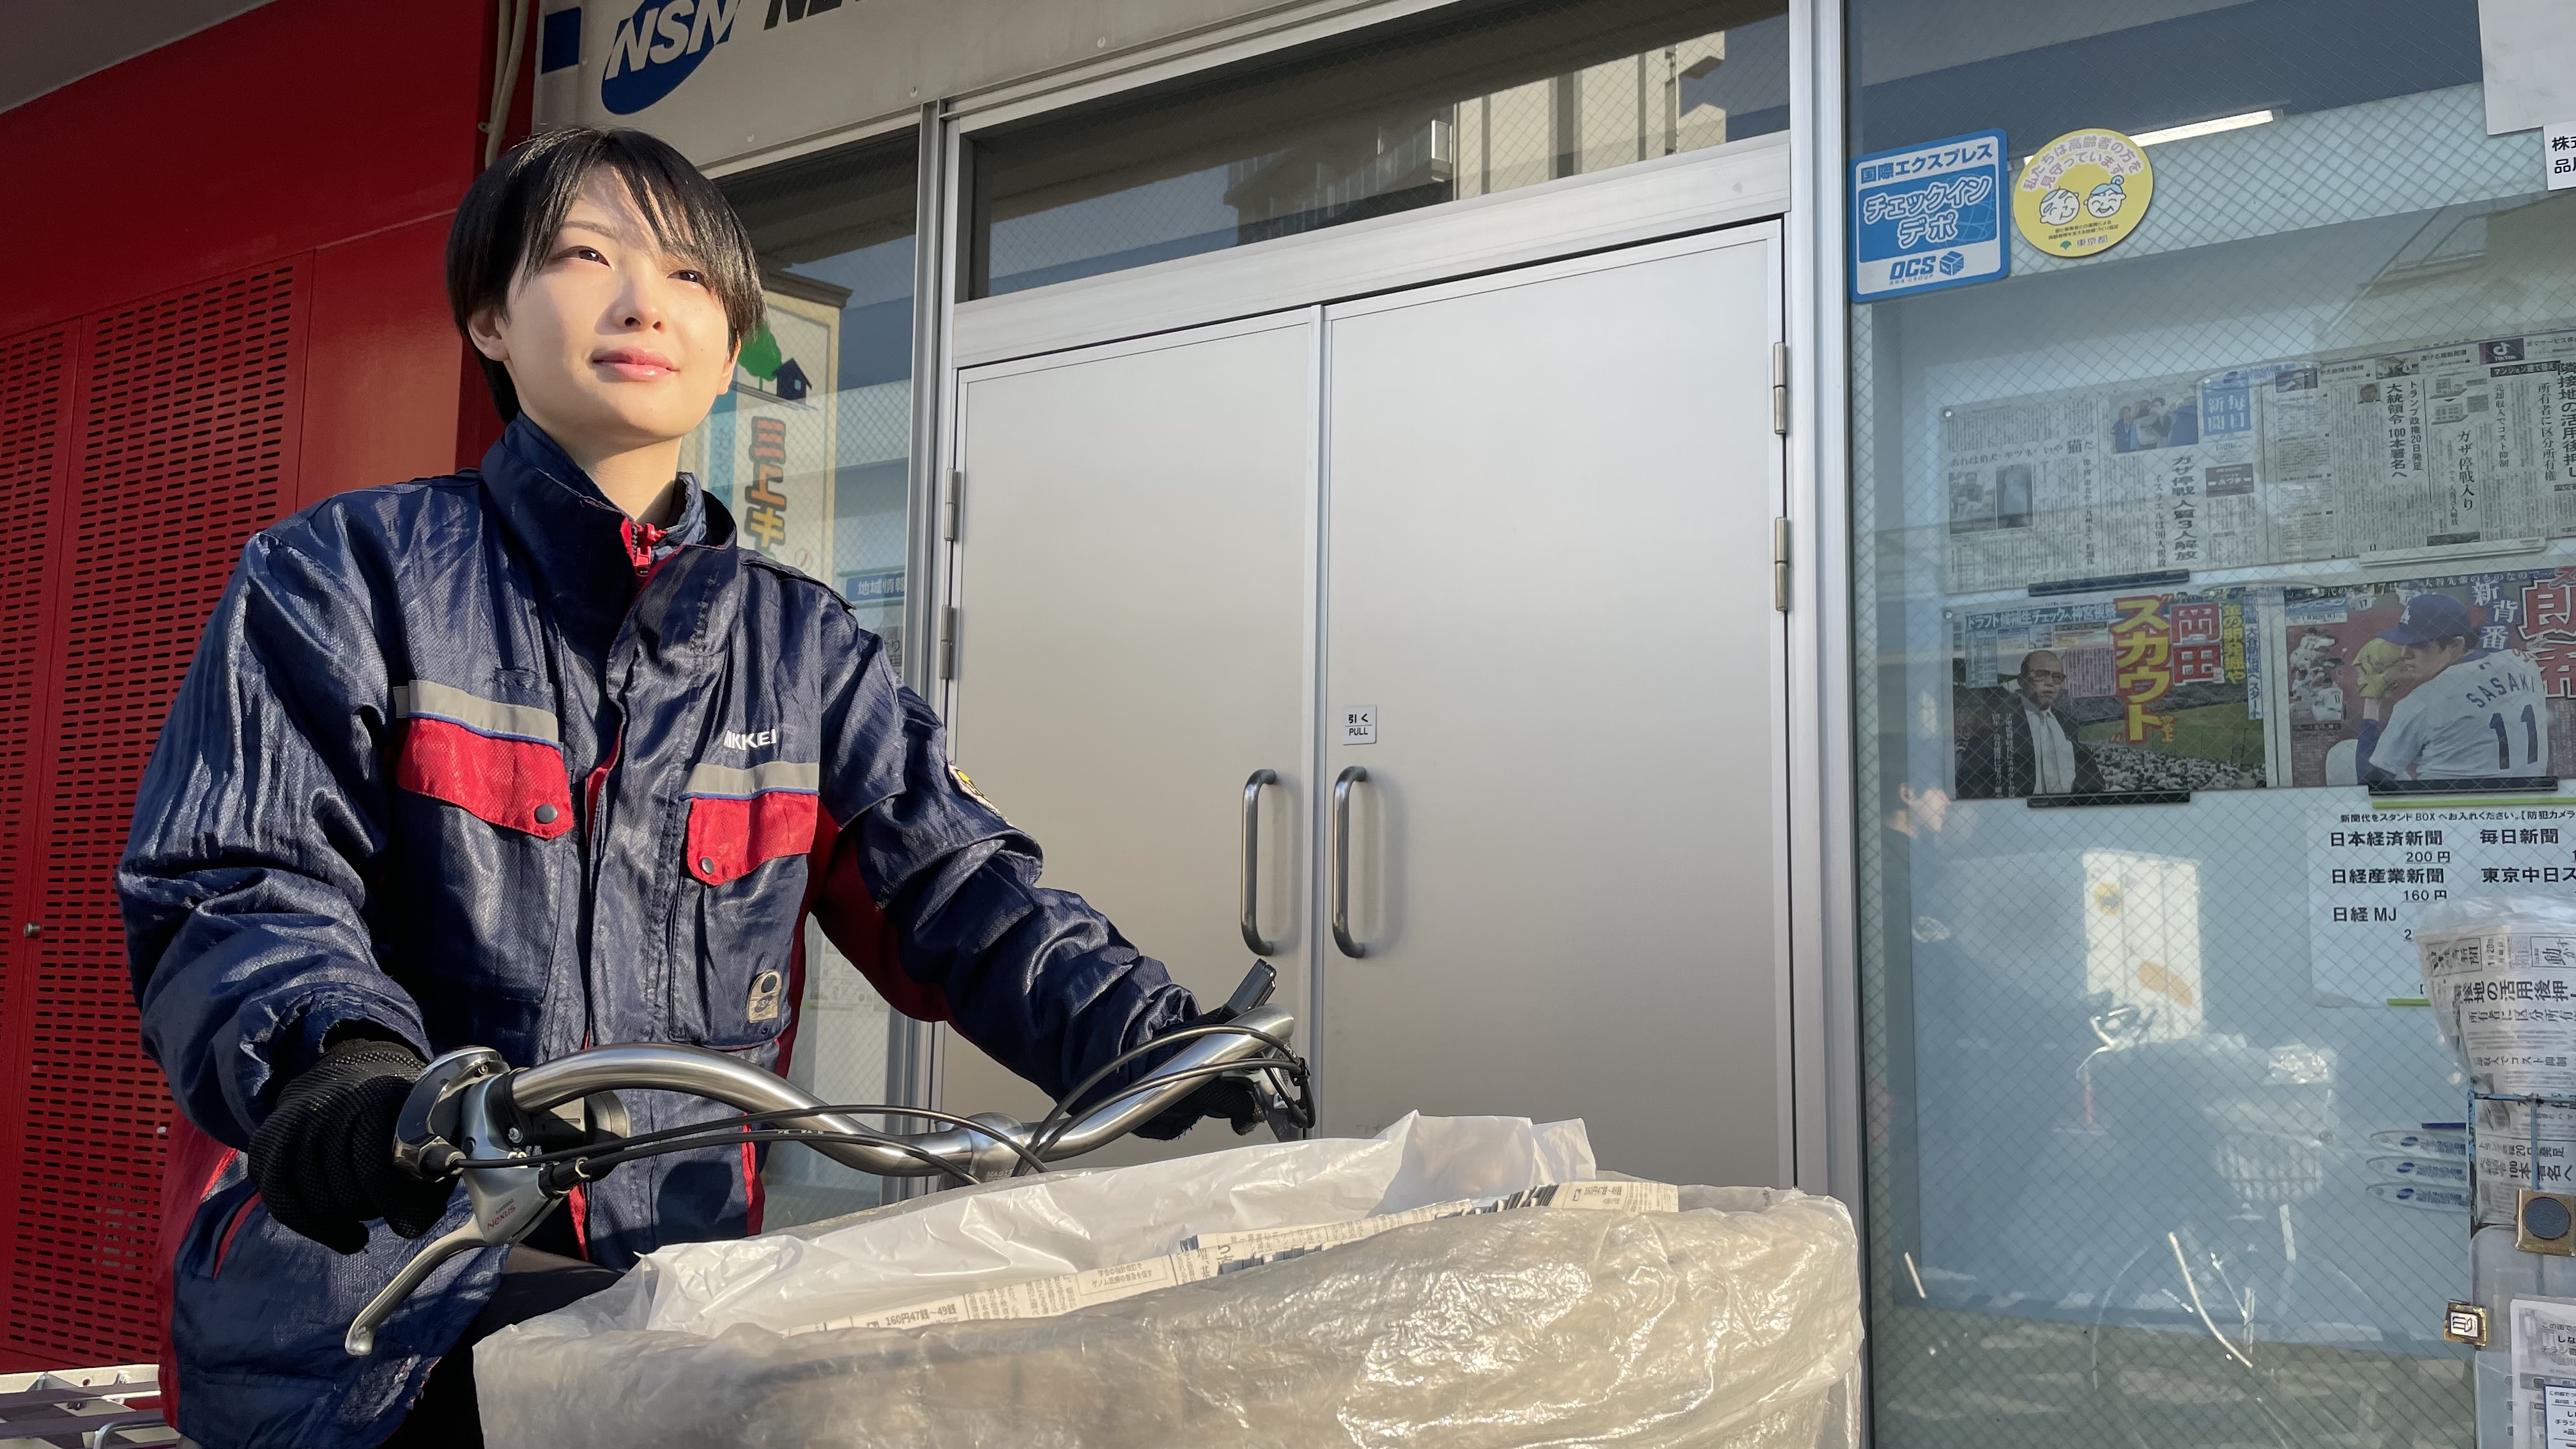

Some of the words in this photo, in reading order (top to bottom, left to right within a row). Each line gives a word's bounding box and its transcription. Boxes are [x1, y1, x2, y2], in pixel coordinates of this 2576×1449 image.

[604, 0, 741, 80] NSN
[1860, 143, 1993, 184] 国際エクスプレス
[2022, 135, 2142, 190] 私たちは高齢者の方を
[2040, 152, 2124, 189] 見守っています
[1864, 176, 1992, 224] チェックイン
[1897, 210, 1958, 249] デポ
[2077, 234, 2108, 247] 東京都
[1889, 256, 1936, 280] OCS
[2465, 672, 2535, 709] SASAKI
[1349, 714, 1368, 723] 引く
[1349, 727, 1368, 736] PULL
[2489, 704, 2539, 770] 11
[2415, 813, 2435, 822] BOX
[2331, 830, 2443, 847] 日本経済新聞
[2480, 829, 2559, 845] 毎日新聞
[2406, 851, 2432, 862] 200
[2437, 851, 2451, 862] 円
[2332, 868, 2444, 884] 日経産業新聞
[2404, 890, 2429, 901] 160
[2434, 890, 2448, 901] 円
[2333, 907, 2369, 923] 日経
[2374, 907, 2397, 922] MJ
[2468, 1009, 2576, 1023] 所有者に区分所有
